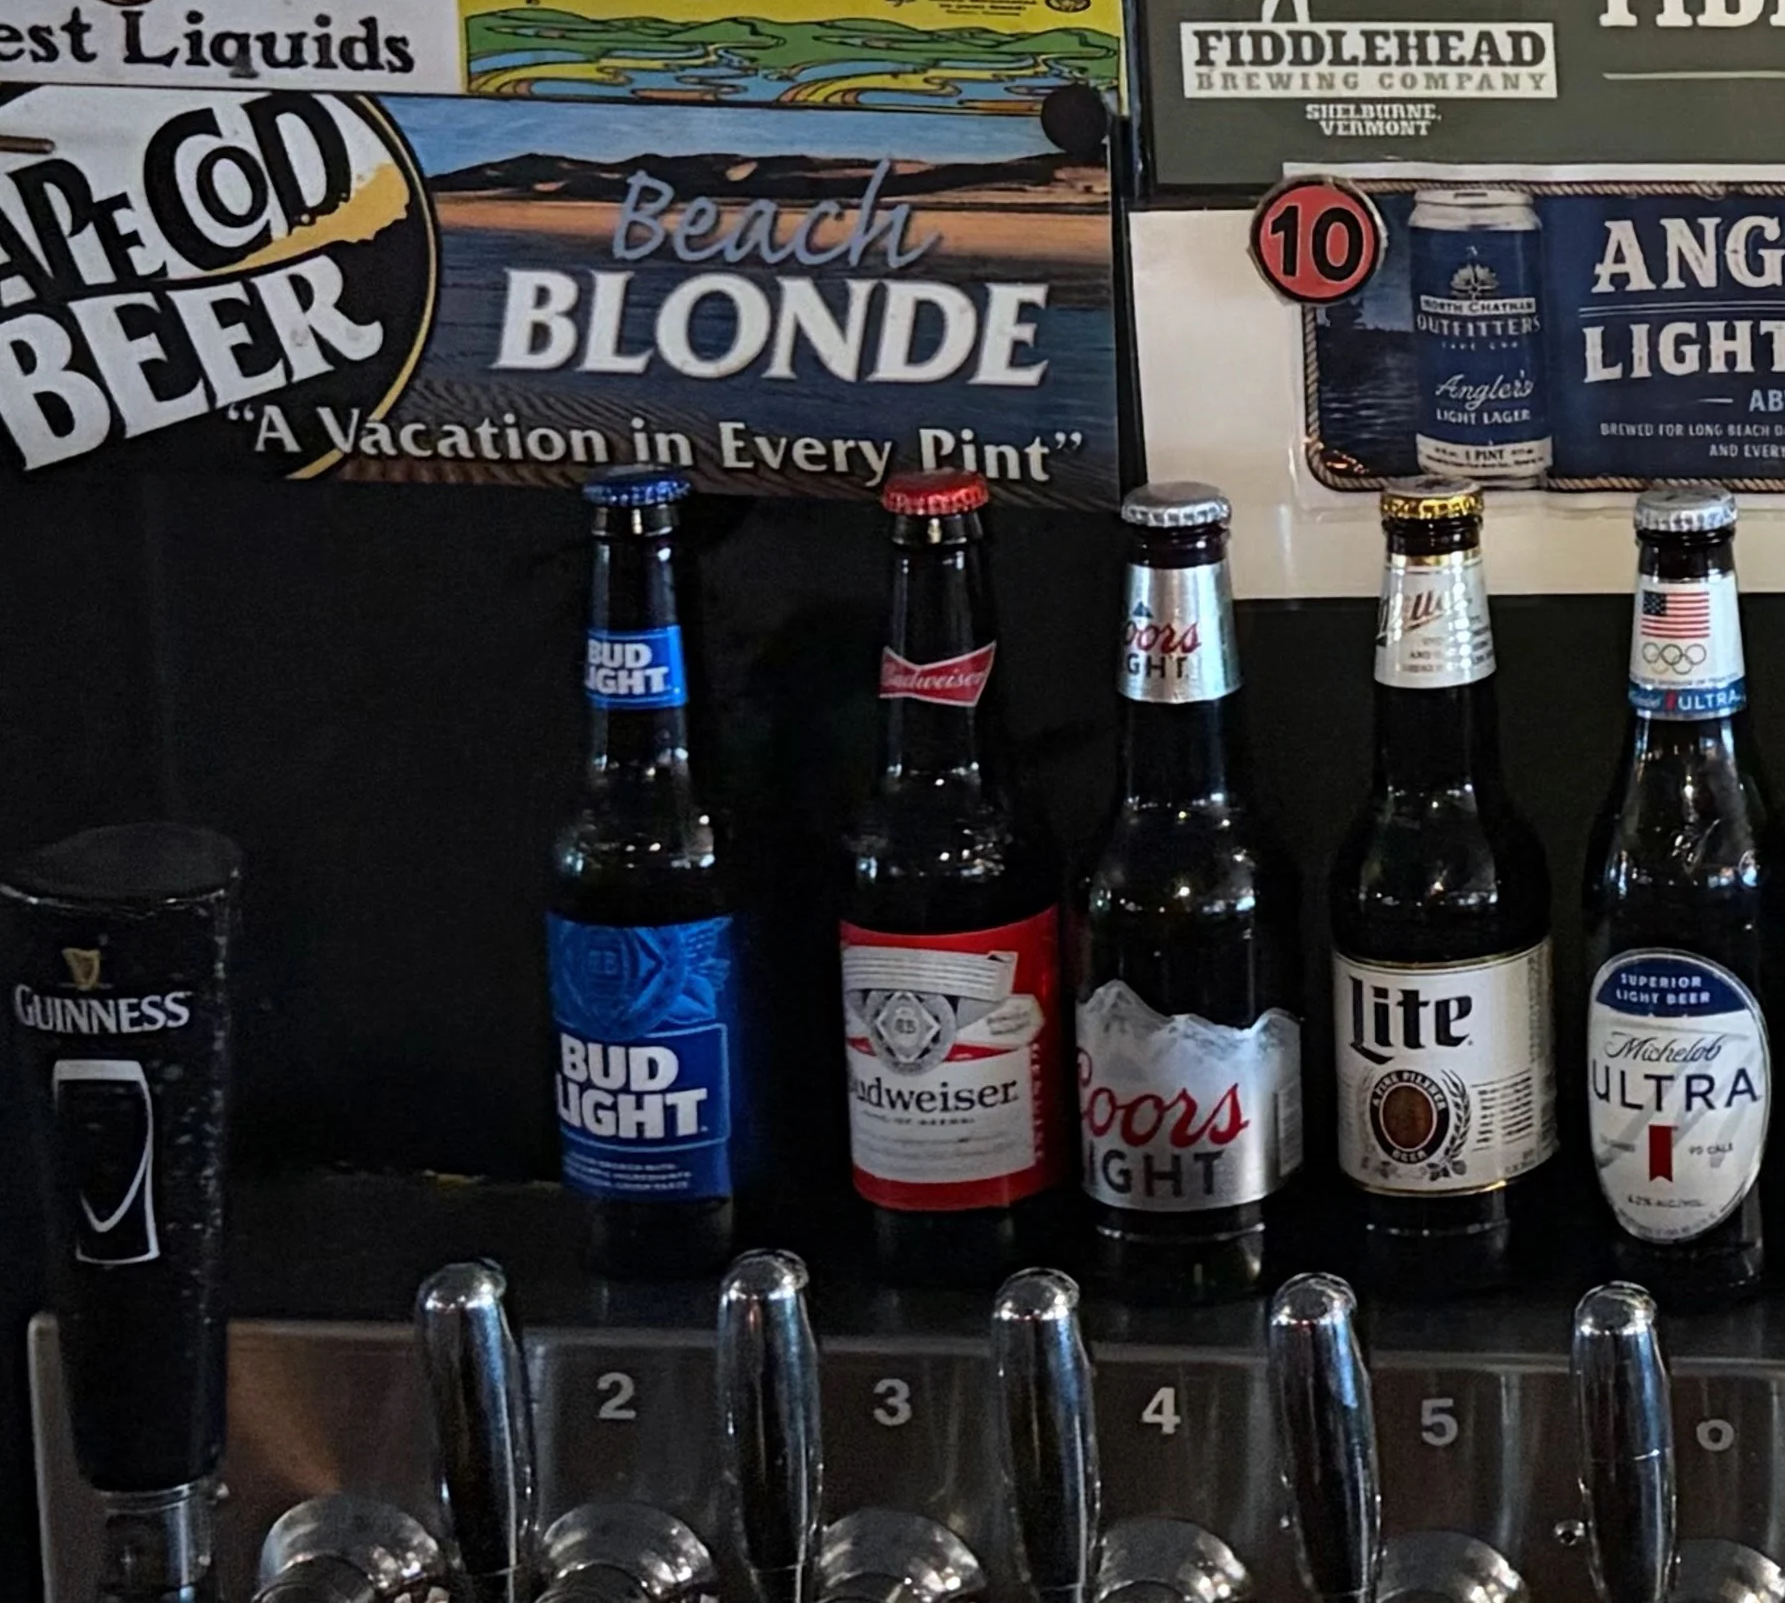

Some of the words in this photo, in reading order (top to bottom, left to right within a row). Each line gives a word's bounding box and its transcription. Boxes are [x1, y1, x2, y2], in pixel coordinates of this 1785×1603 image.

[613, 160, 942, 269] Beach
[1268, 205, 1369, 281] 10
[491, 268, 1048, 388] BLONDE
[0, 256, 382, 471] BEER
[319, 408, 620, 467] Vacation
[632, 417, 694, 467] in
[721, 422, 891, 485] Every
[920, 428, 1084, 482] Pint"
[15, 985, 190, 1034] GUINNESS
[1349, 975, 1473, 1063] Lite
[559, 1036, 679, 1089] BUD
[1604, 1032, 1722, 1064] Michelob
[1593, 1065, 1760, 1112] ULTRA
[597, 1373, 638, 1420] 2
[873, 1379, 912, 1425] 3
